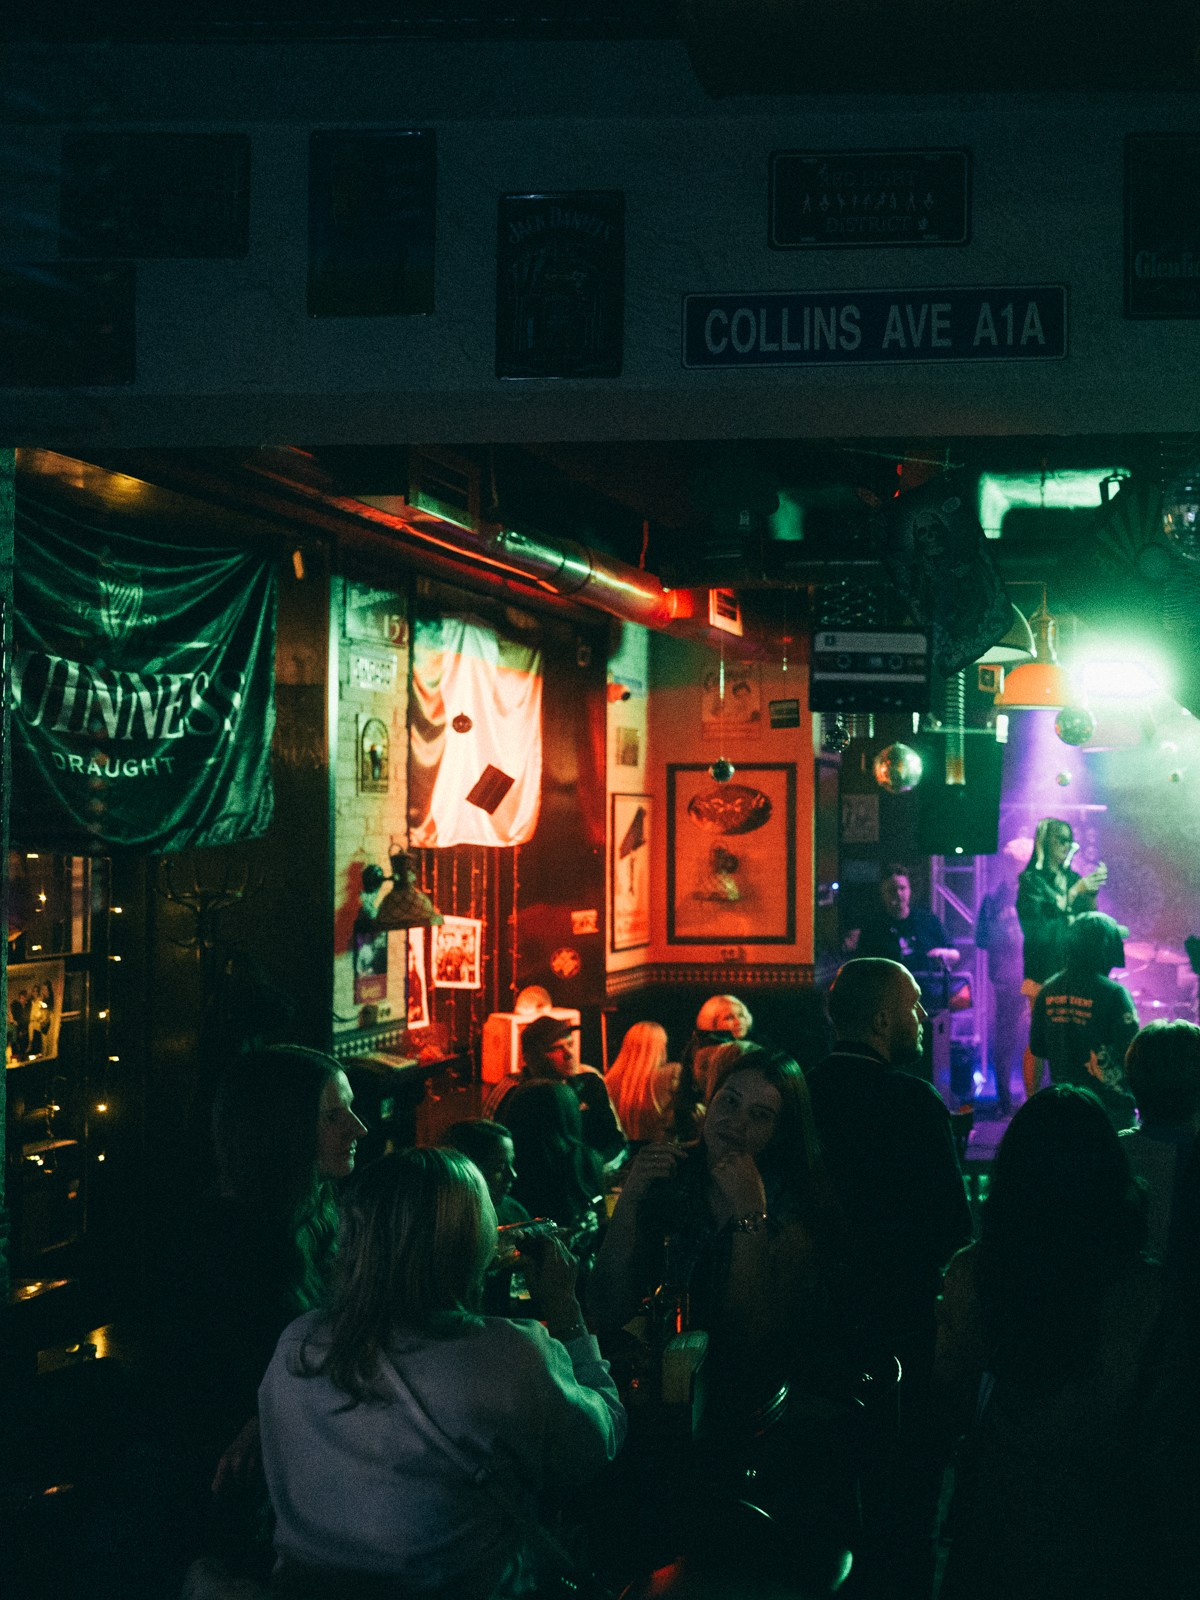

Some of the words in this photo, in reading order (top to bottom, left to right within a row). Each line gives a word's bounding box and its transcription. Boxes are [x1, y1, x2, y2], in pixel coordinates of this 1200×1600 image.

[825, 213, 912, 233] DISTRICT
[704, 304, 863, 355] COLLINS
[881, 302, 953, 351] AVE
[973, 301, 1047, 348] A1A
[10, 652, 247, 742] UINNESS
[50, 750, 176, 779] DRAUGHT
